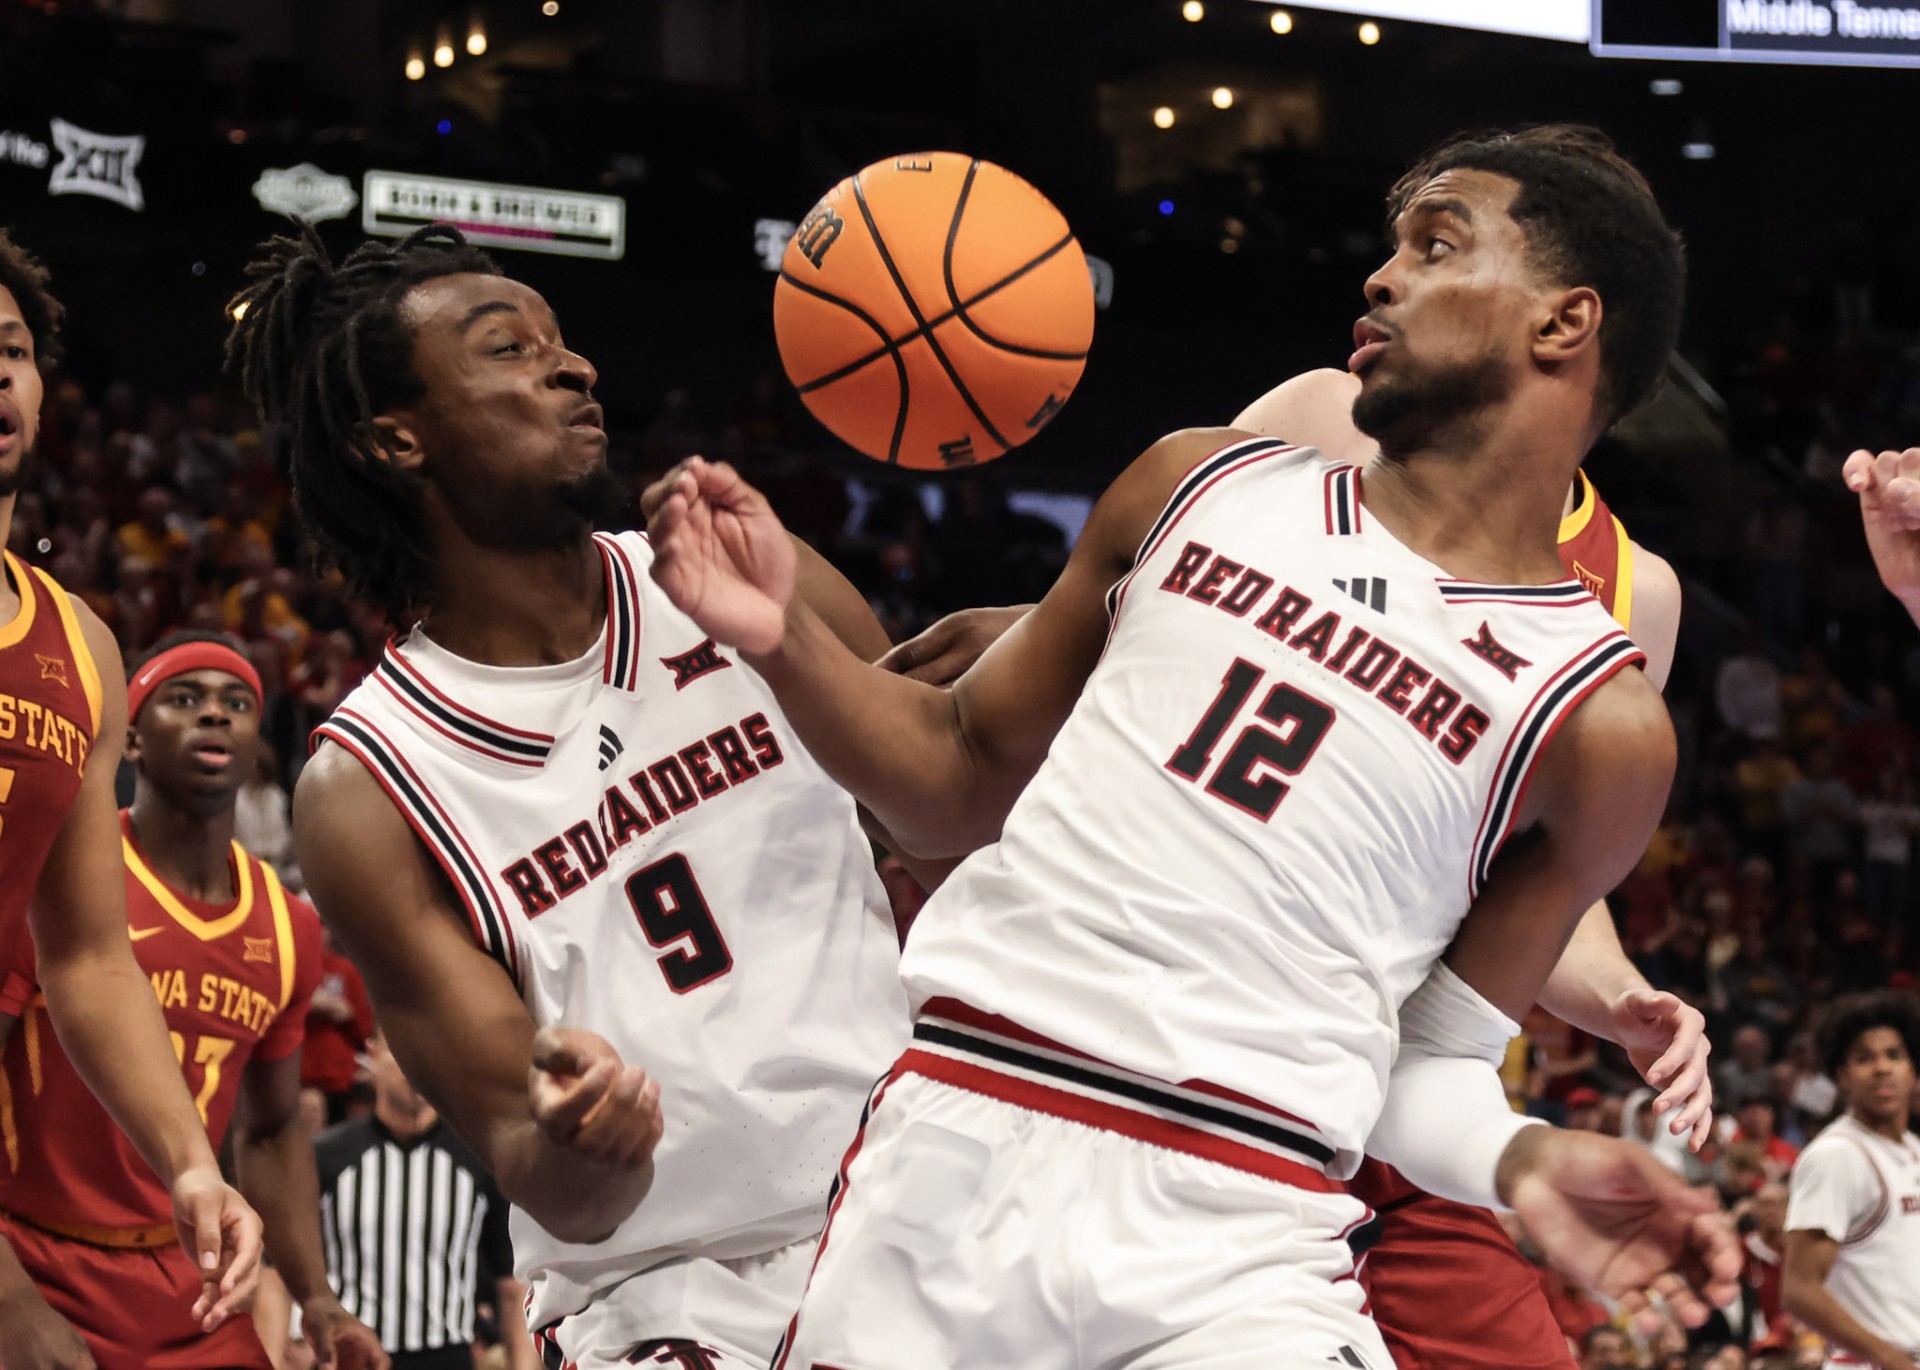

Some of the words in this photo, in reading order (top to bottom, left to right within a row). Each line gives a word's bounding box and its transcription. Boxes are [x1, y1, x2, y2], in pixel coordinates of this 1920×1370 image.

[1726, 0, 1832, 36] Middle
[1158, 541, 1275, 618] RED
[1254, 586, 1491, 765] RAIDERS
[500, 819, 609, 921] RED
[598, 712, 785, 859] AIDERS
[1163, 656, 1336, 824] 12
[624, 852, 734, 995] 9
